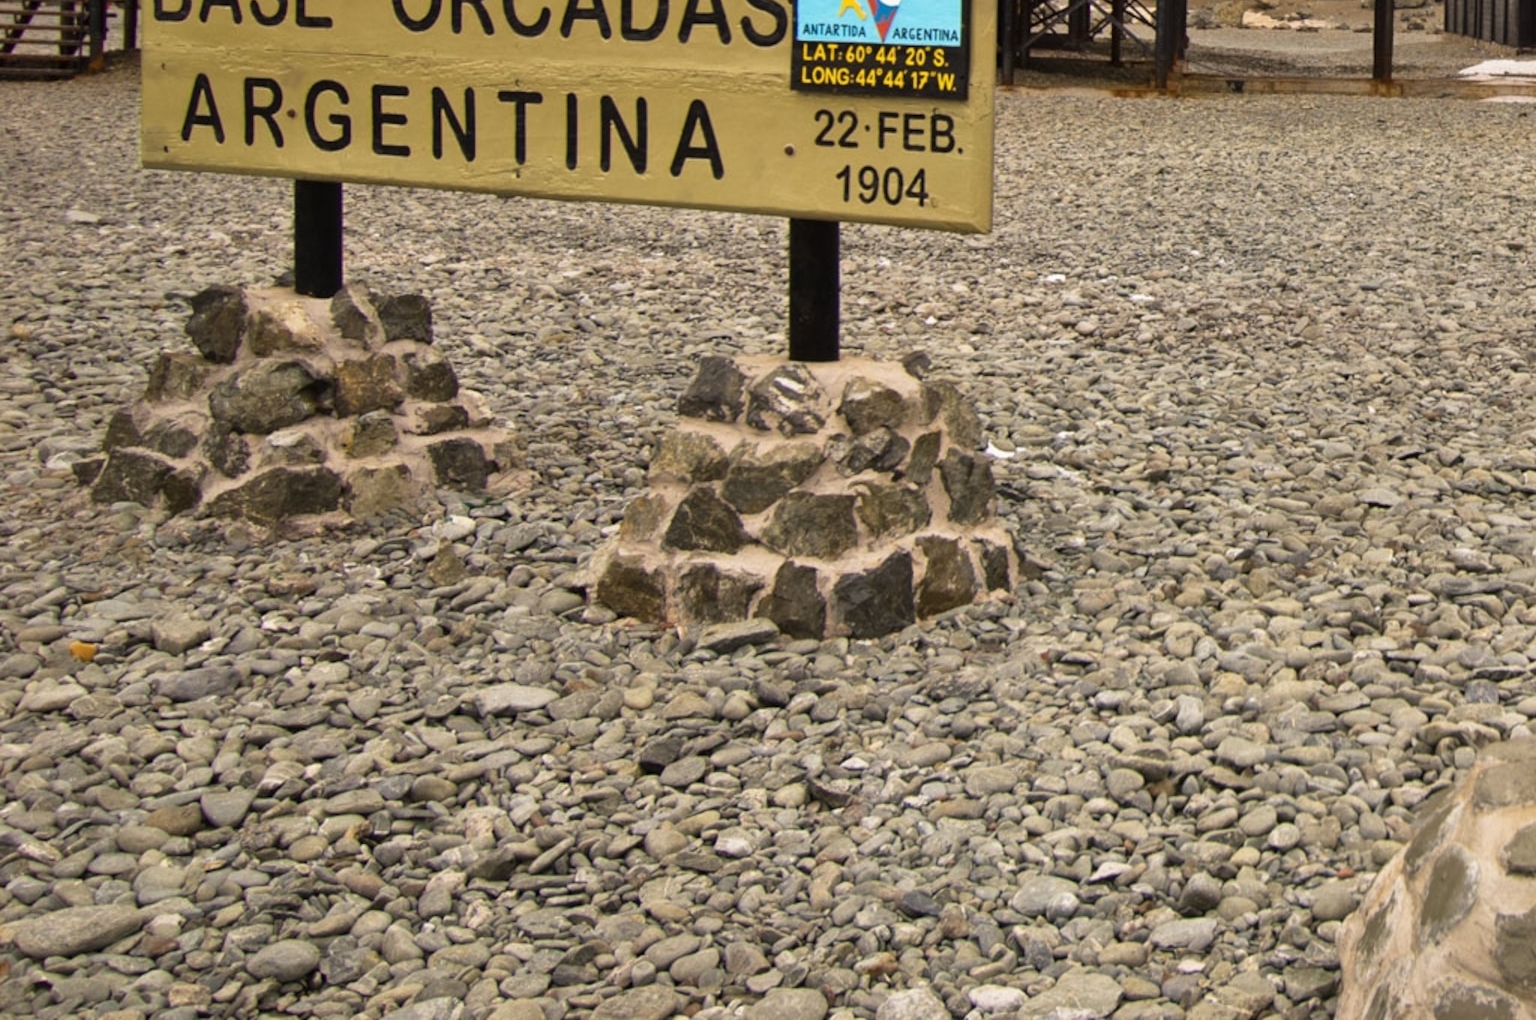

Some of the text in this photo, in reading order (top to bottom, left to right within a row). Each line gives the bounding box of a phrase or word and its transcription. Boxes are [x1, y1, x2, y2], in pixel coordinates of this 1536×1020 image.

[802, 22, 960, 42] ANTARTIDA ARGENTINA
[181, 72, 725, 181] ARGENTINA
[836, 164, 929, 208] 1904
